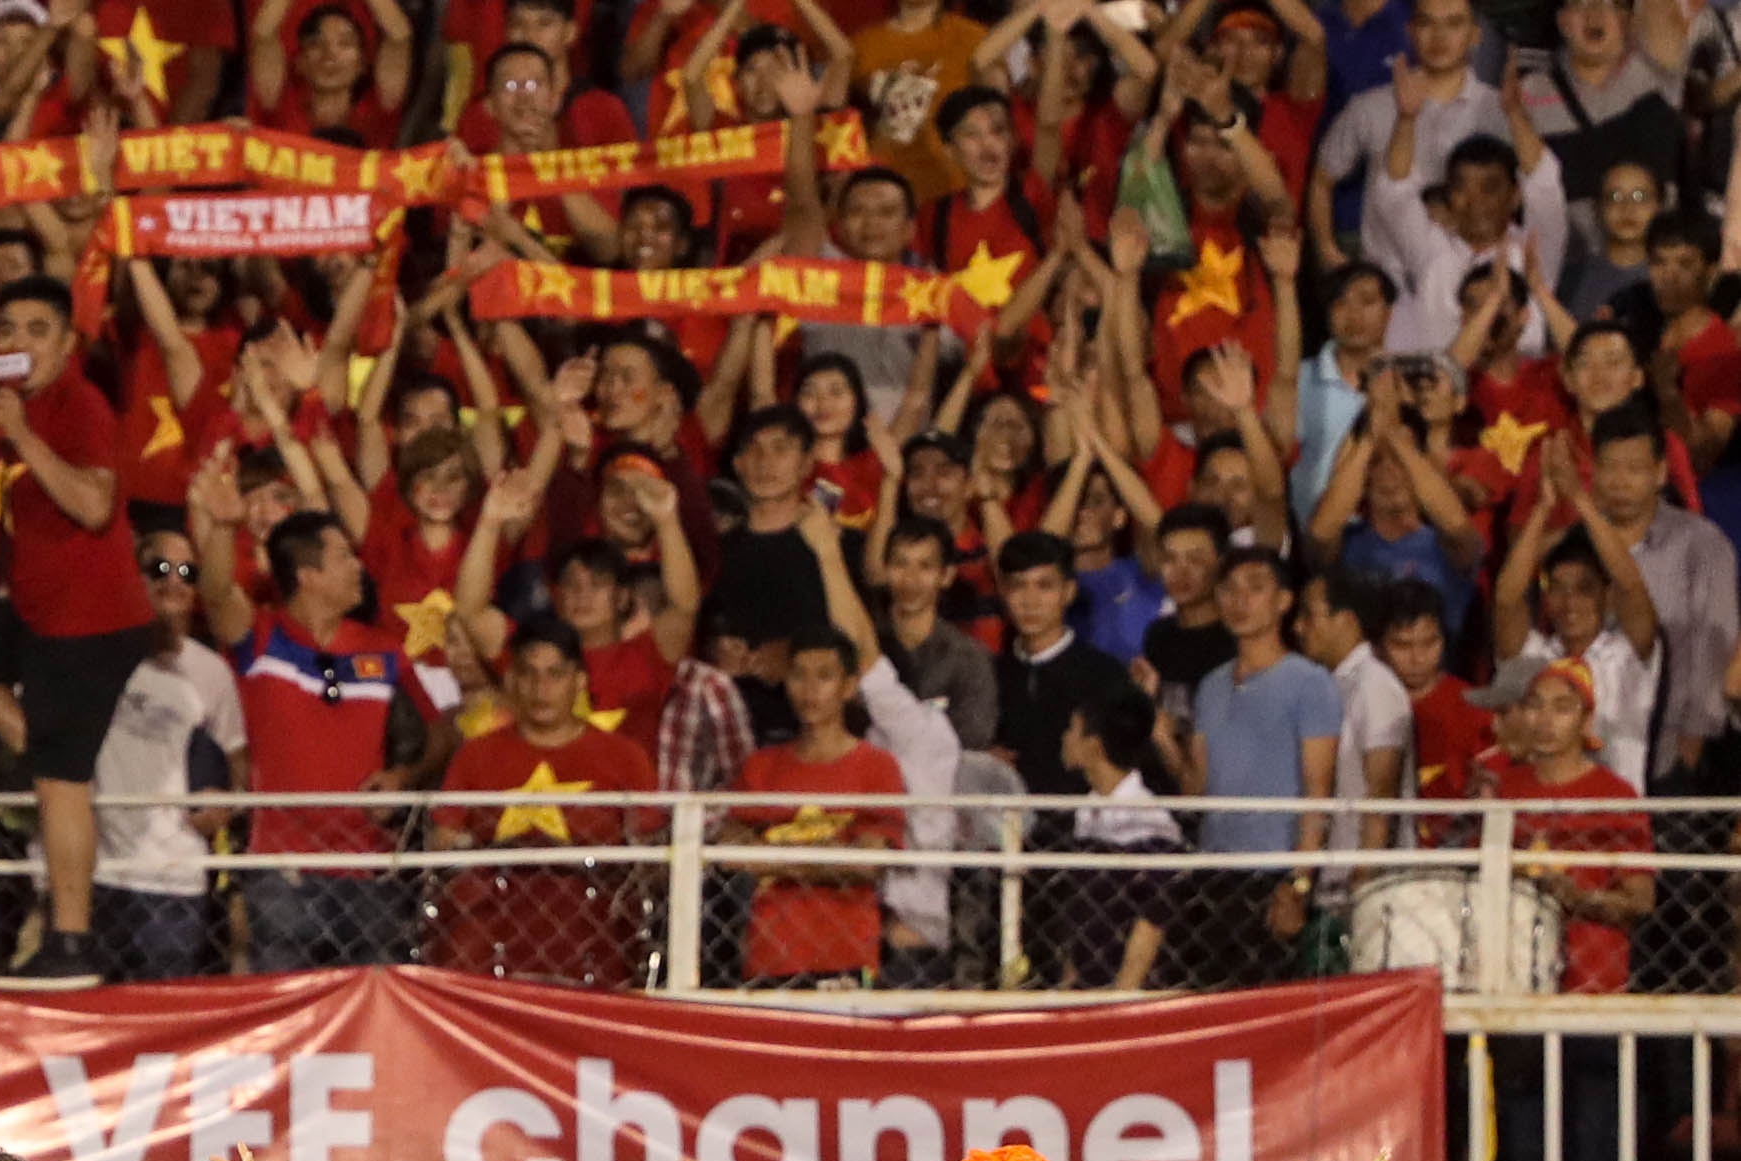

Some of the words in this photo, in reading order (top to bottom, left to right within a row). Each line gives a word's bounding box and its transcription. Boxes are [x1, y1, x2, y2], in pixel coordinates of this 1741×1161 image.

[243, 137, 335, 186] NAM
[656, 125, 756, 169] NAM
[165, 195, 371, 231] VIETNAM
